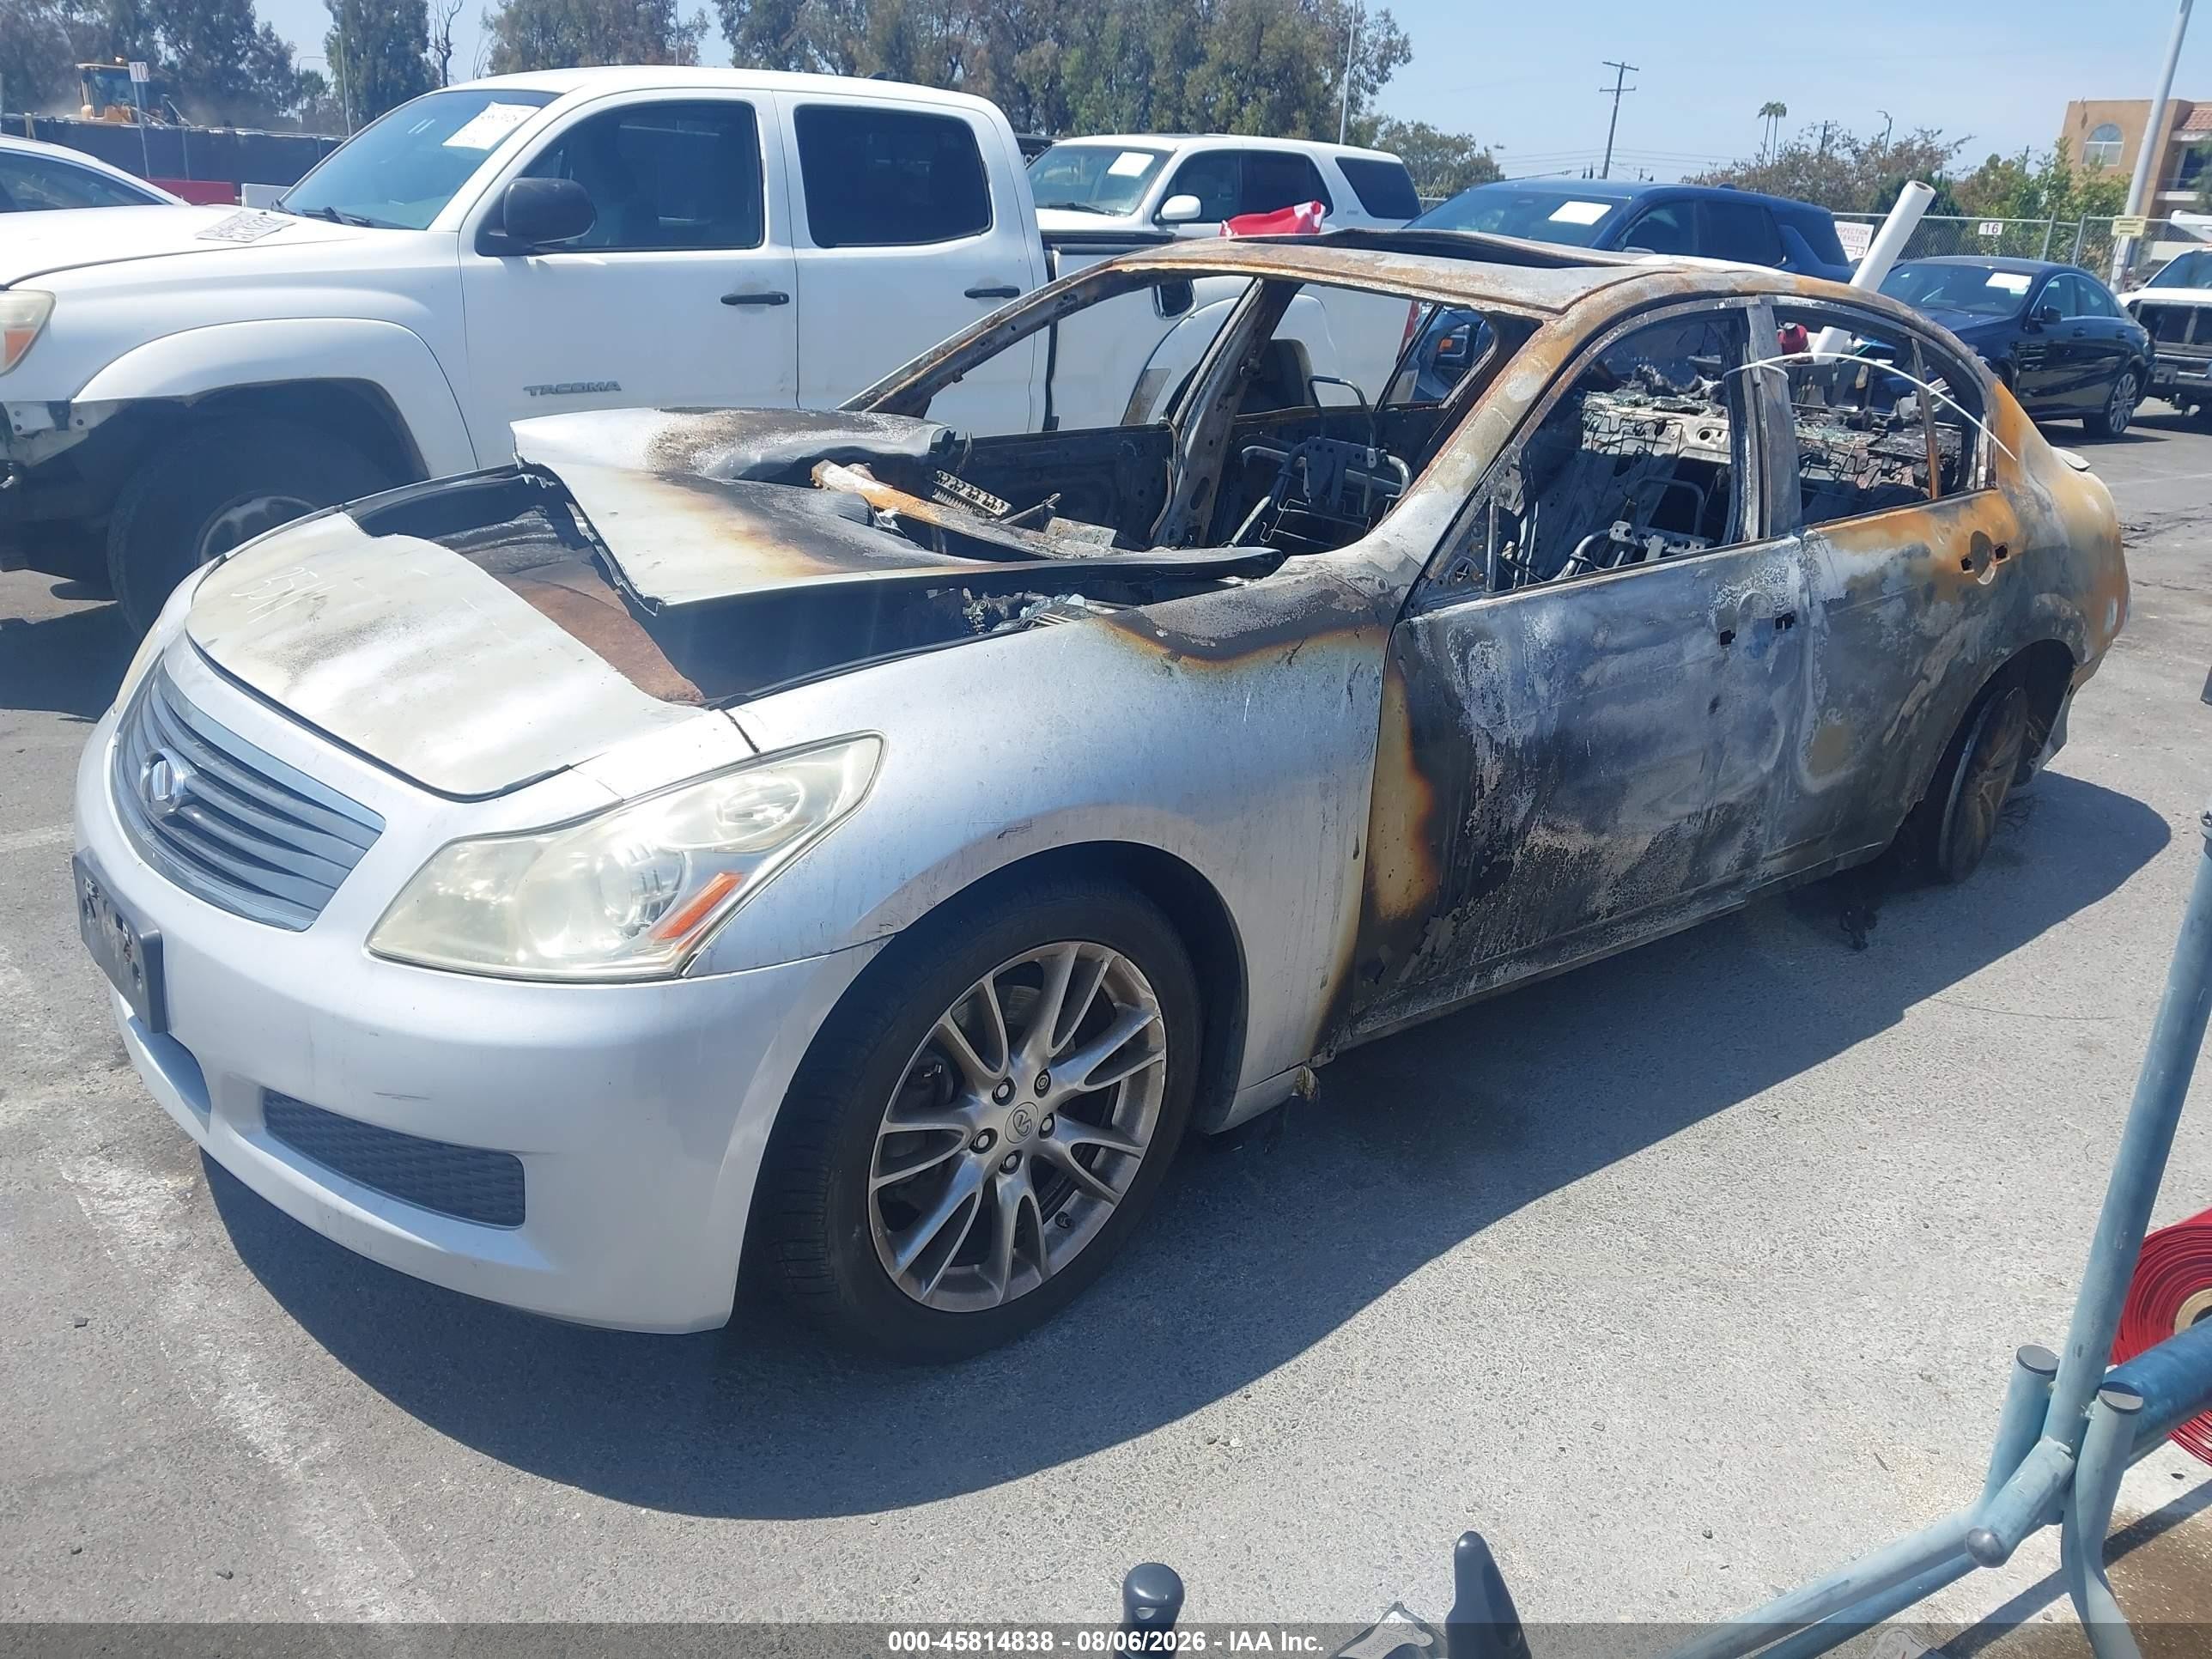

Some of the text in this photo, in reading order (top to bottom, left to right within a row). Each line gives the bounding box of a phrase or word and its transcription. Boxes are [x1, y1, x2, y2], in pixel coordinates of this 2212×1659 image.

[134, 63, 148, 80] 10
[1984, 223, 1999, 234] 16
[522, 380, 622, 396] TACOMA
